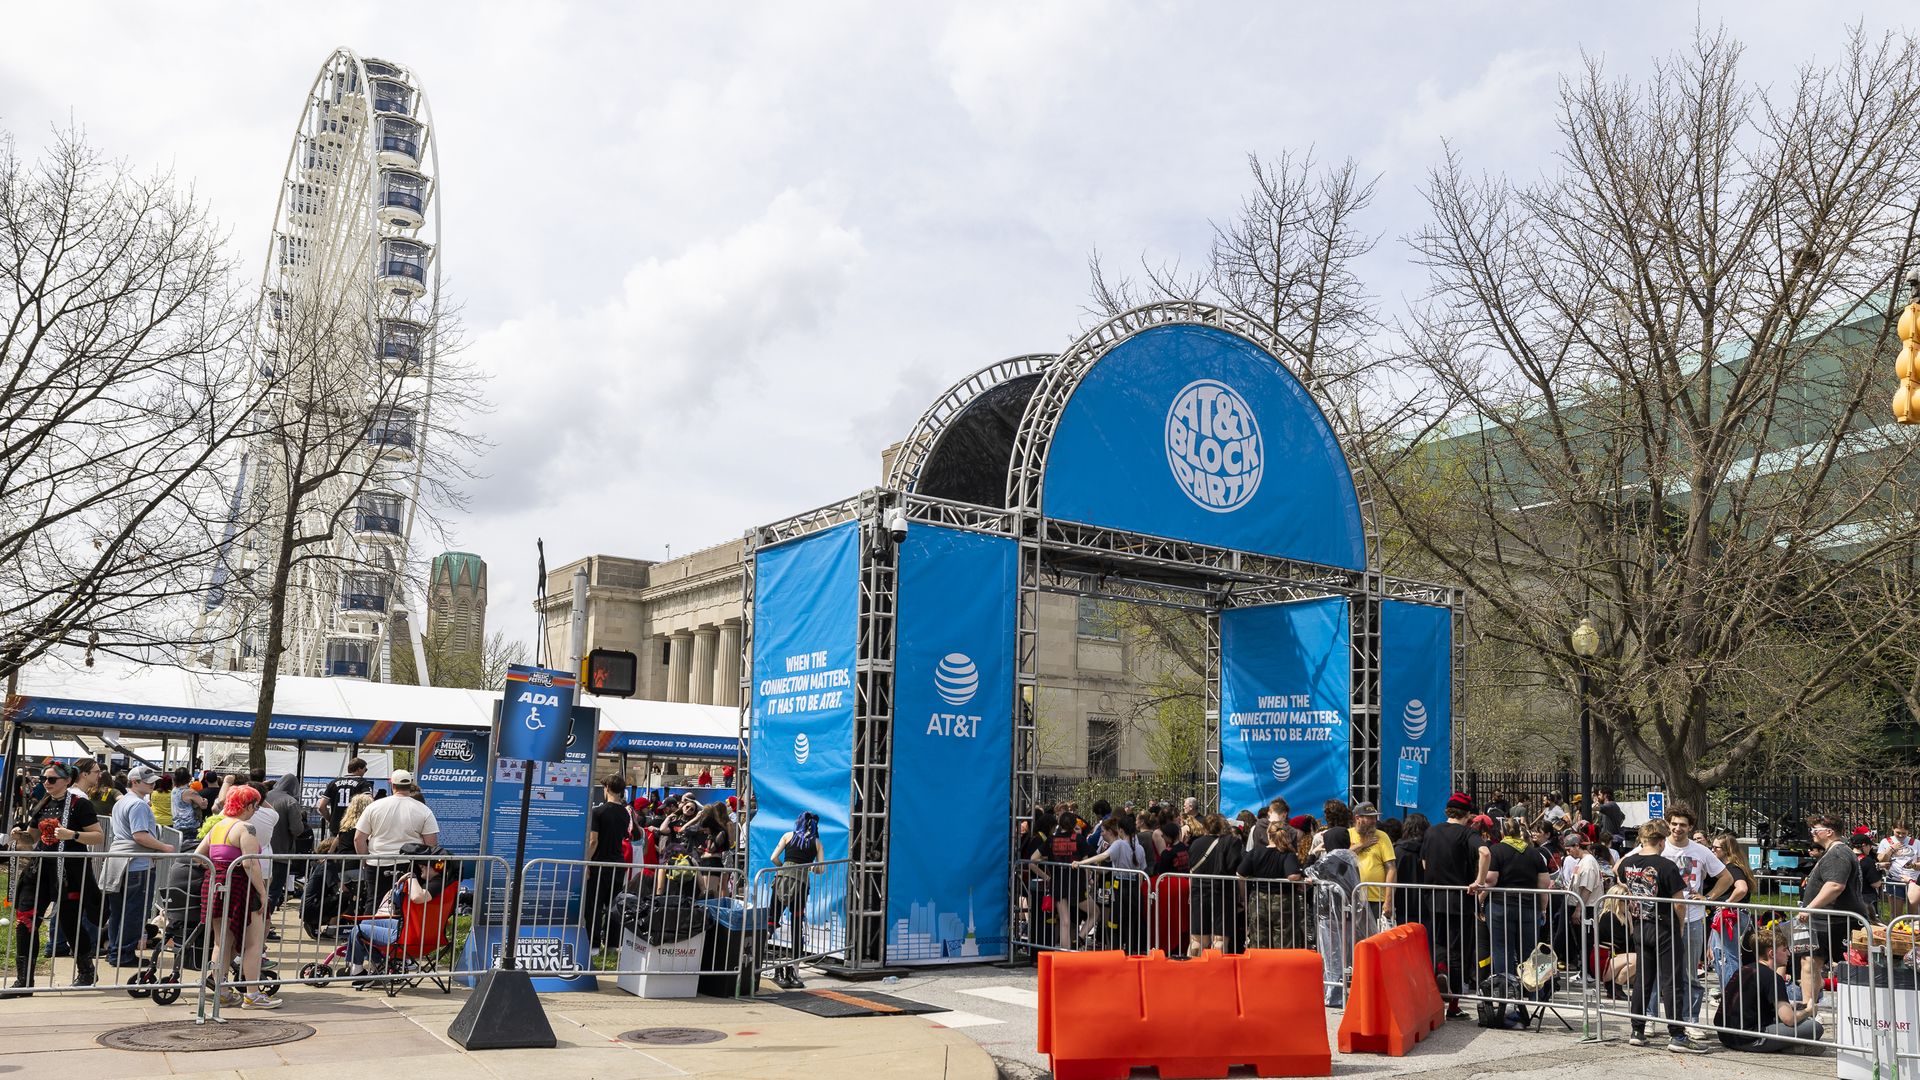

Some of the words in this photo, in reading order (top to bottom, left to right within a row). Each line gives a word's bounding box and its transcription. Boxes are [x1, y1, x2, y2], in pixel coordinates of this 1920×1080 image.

[1173, 386, 1252, 441] AT&T
[1170, 415, 1260, 475] BLOCK
[1170, 449, 1260, 506] PARTY
[785, 653, 810, 673] WHEN
[811, 650, 828, 669] THE
[759, 674, 810, 696] CONNECTION
[810, 668, 851, 689] MATTERS,
[517, 691, 559, 707] ADA
[767, 699, 778, 716] IT
[777, 697, 795, 714] HAS
[795, 695, 807, 713] TO
[807, 693, 820, 711] BE
[819, 691, 843, 710] AT&T.
[1258, 695, 1288, 709] WHEN
[1290, 694, 1310, 708] THE
[46, 706, 115, 719] WELCOME
[118, 712, 136, 721] TO
[137, 713, 188, 725] MARCH
[189, 717, 252, 728] MADNESS
[268, 722, 298, 731] USIC
[299, 724, 354, 734] FESTIVAL
[926, 712, 982, 738] AT&T
[1229, 711, 1289, 726] CONNECTION
[1289, 710, 1342, 727] MATTERS,
[1240, 728, 1250, 742] IT
[1252, 728, 1272, 741] HAS
[1273, 728, 1287, 741] TO
[1289, 727, 1303, 741] BE
[1303, 727, 1333, 741] AT&T.
[440, 742, 467, 750] MUSIC
[628, 738, 674, 748] WELCOME
[688, 741, 722, 750] MARCH
[433, 748, 474, 761] FESTIVAL
[1400, 745, 1431, 765] AT&T
[420, 774, 485, 783] DISCLAIMER
[429, 767, 477, 776] LIABILITY
[337, 787, 352, 807] 11
[1847, 1016, 1911, 1031] VENUSMART
